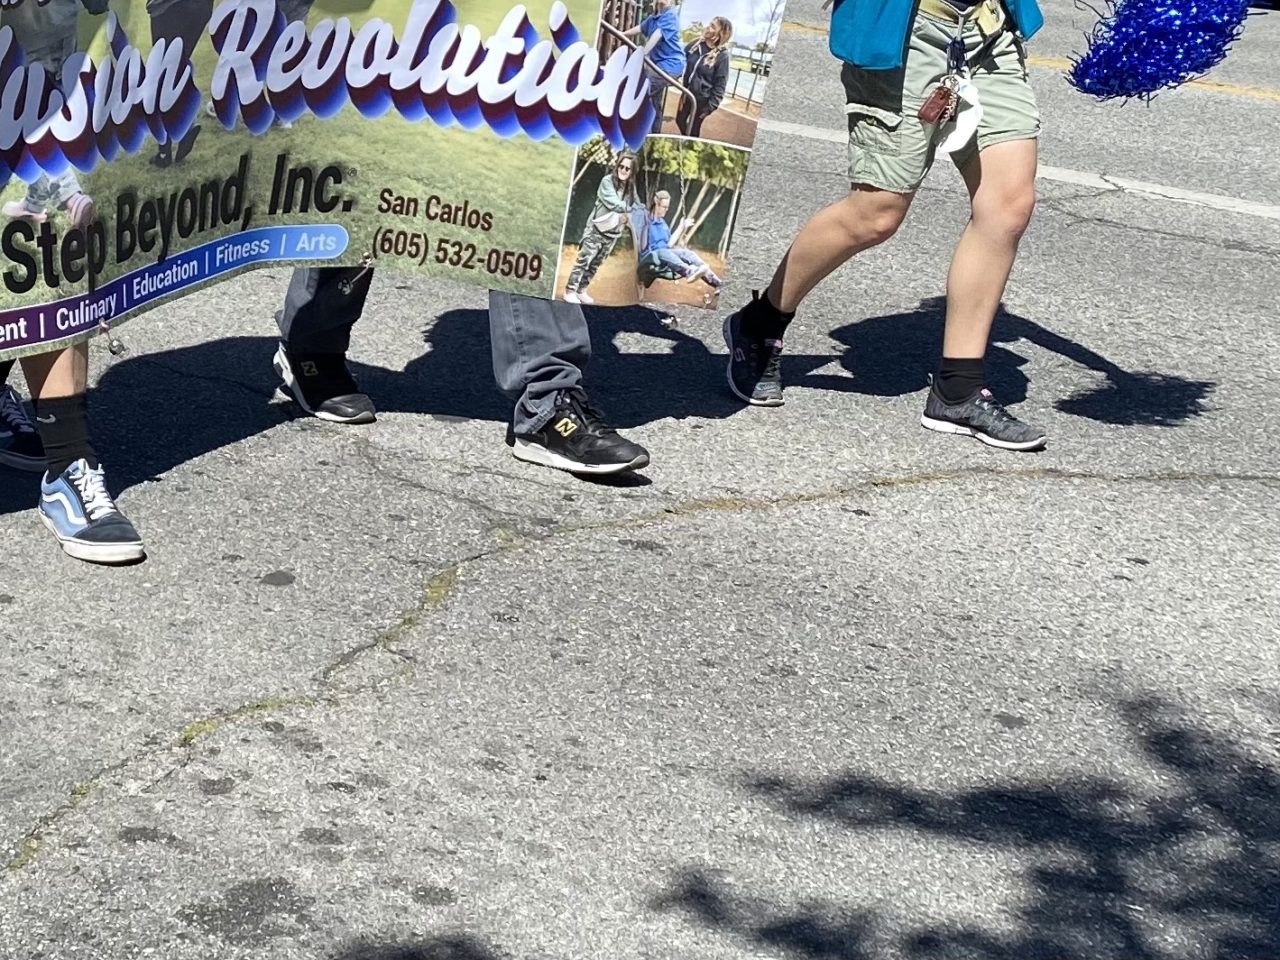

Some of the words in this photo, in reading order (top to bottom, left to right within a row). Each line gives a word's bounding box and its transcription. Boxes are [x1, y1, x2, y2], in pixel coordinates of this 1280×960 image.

[0, 219, 106, 296] Step
[116, 154, 254, 265] Beyond,
[377, 188, 419, 217] San
[425, 195, 494, 231] Carlos
[56, 292, 117, 330] Culinary
[133, 258, 199, 300] Education
[216, 238, 270, 268] Fitness
[296, 233, 337, 252] Arts
[372, 226, 429, 266] (605)
[435, 238, 543, 281] 532-0509
